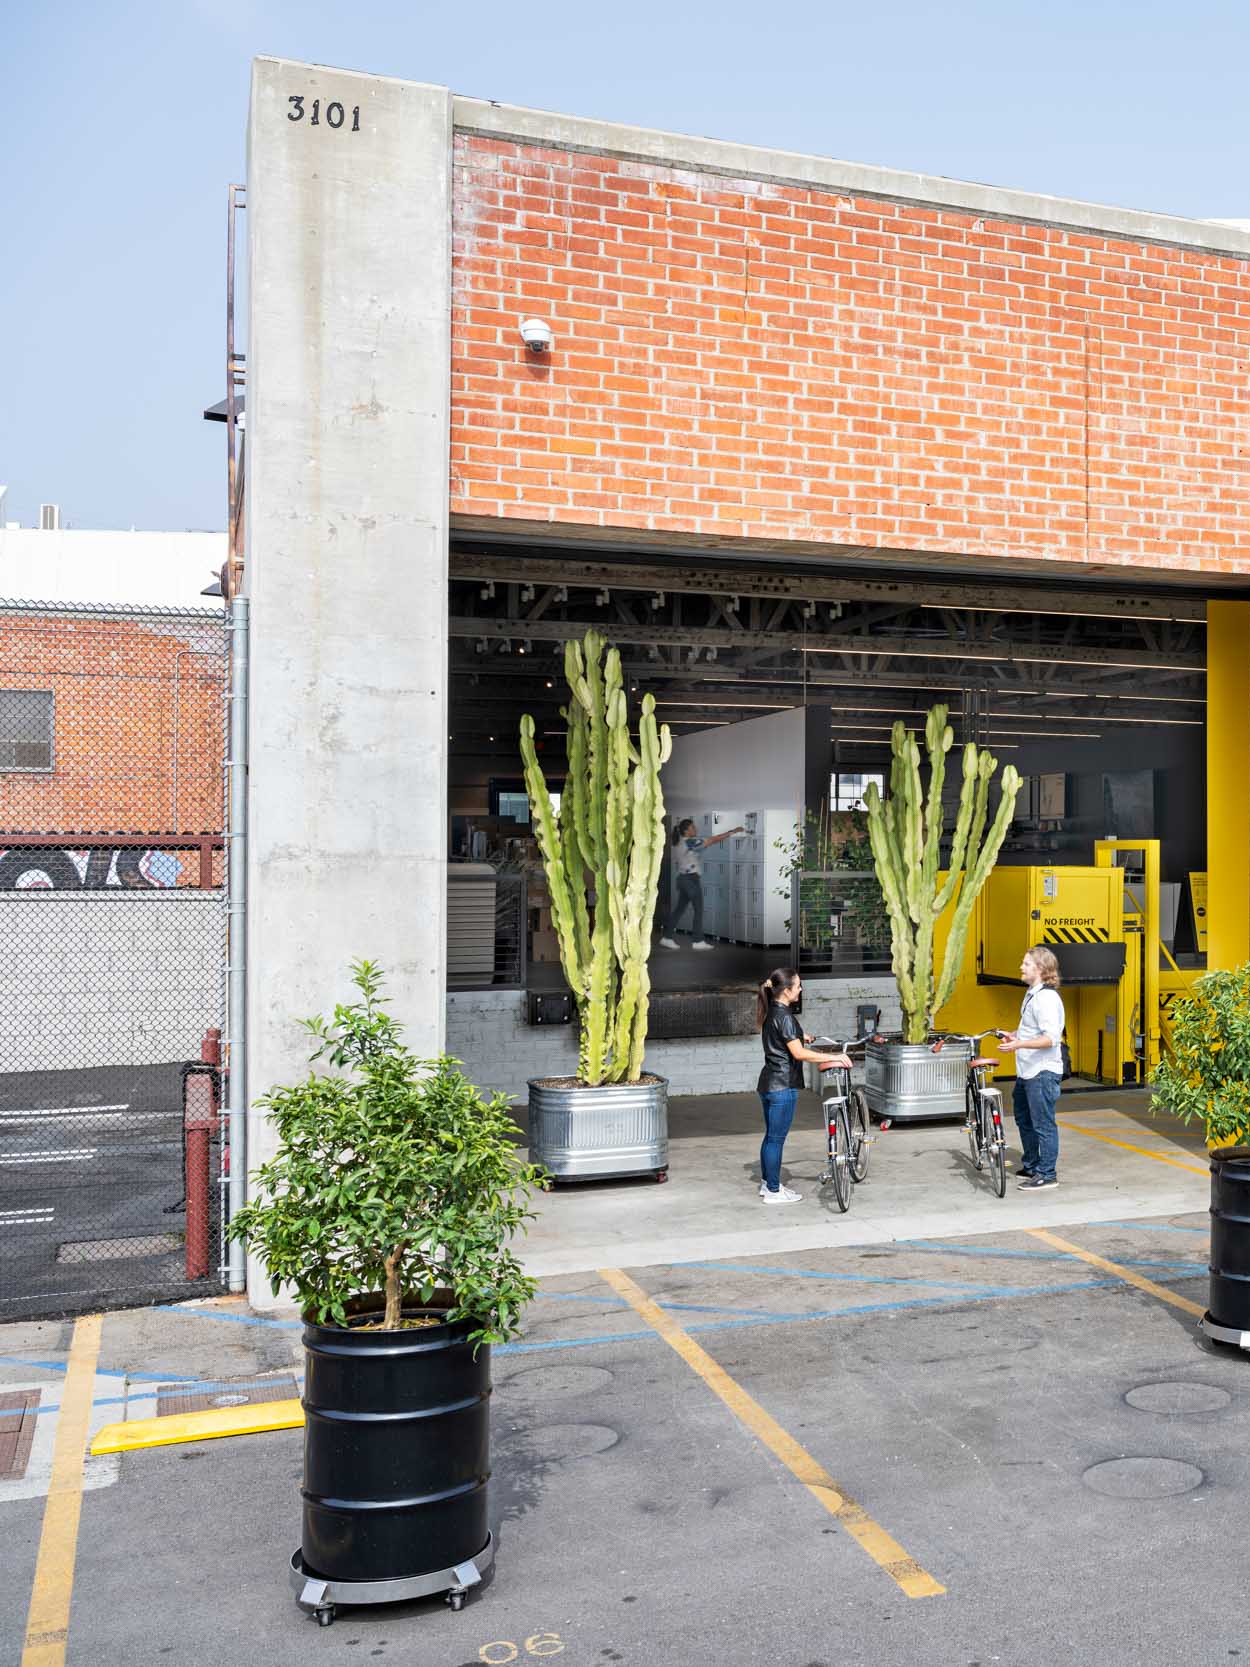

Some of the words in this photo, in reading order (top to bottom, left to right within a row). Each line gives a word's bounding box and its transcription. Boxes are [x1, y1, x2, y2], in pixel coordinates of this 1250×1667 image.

[287, 95, 360, 131] 3101
[1044, 918, 1058, 926] NO
[1059, 918, 1095, 926] FREIGHT
[479, 1632, 567, 1664] 06
